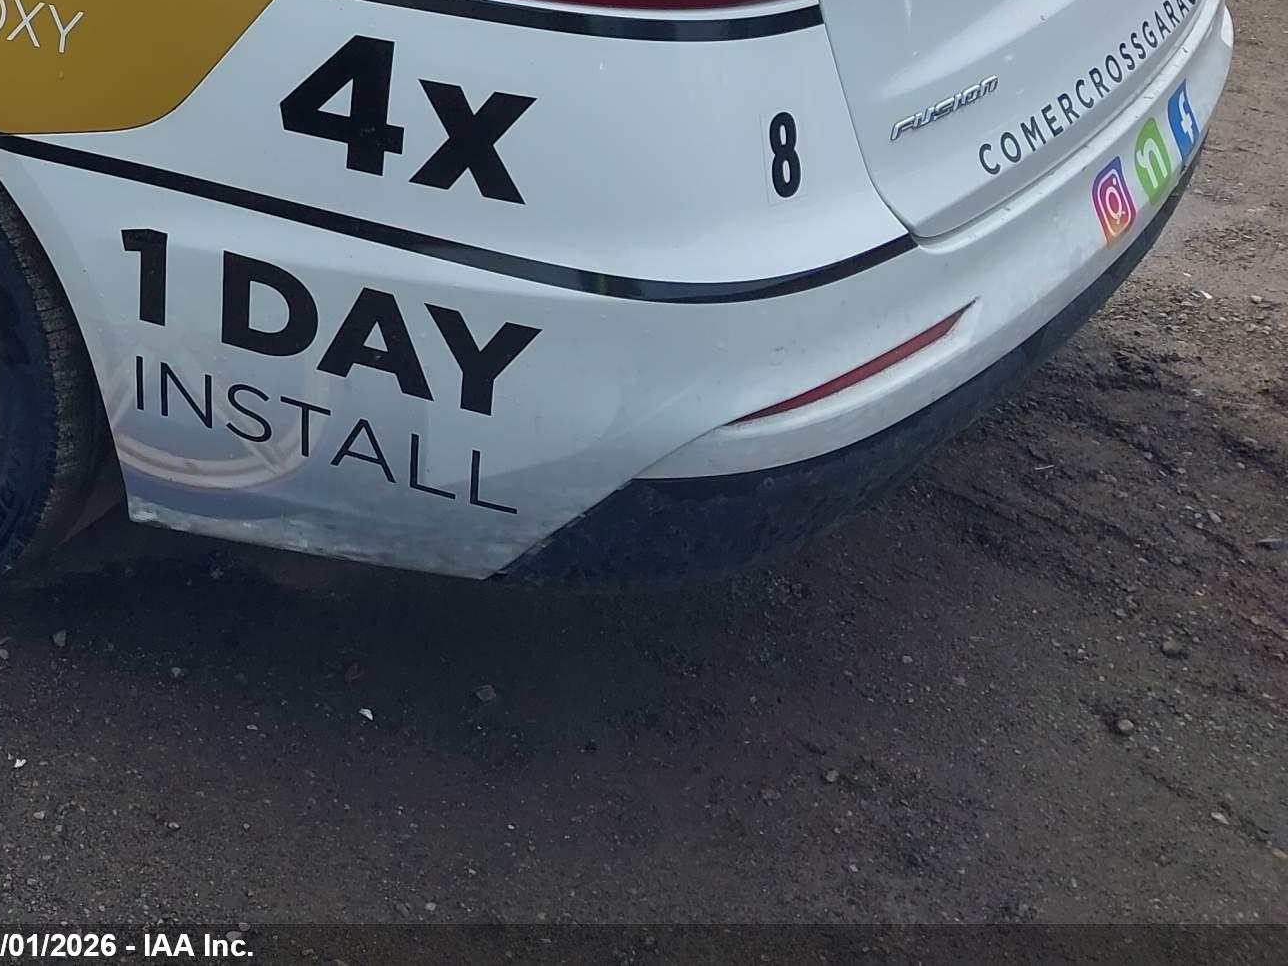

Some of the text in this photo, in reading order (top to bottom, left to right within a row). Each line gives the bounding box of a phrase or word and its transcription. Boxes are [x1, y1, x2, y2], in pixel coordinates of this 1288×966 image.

[769, 111, 803, 199] 8
[121, 228, 543, 417] 1 DAY
[135, 355, 518, 516] INSTALL
